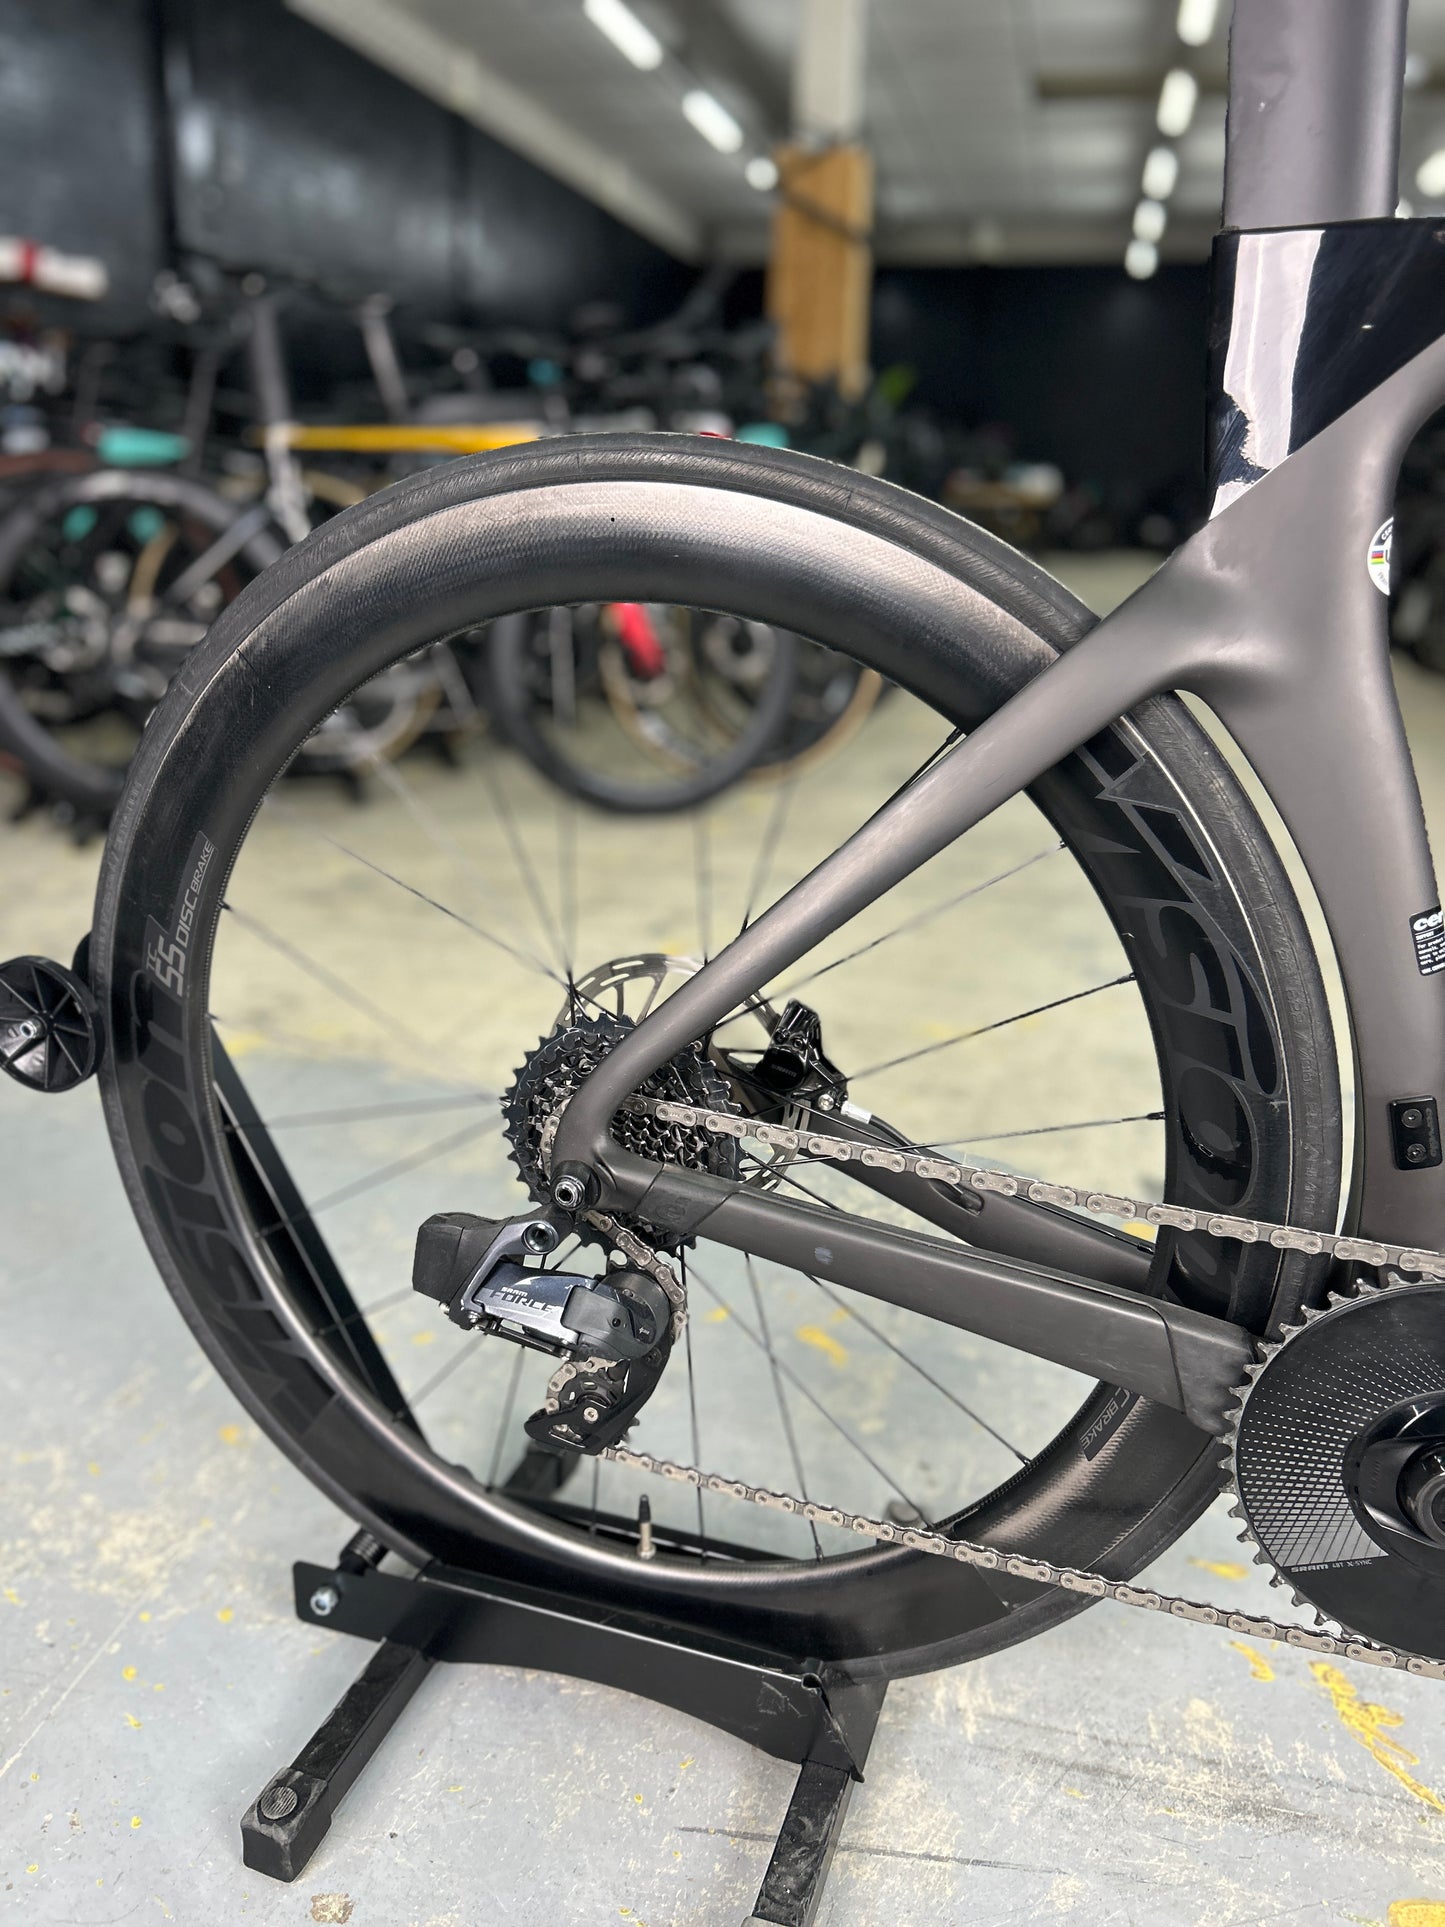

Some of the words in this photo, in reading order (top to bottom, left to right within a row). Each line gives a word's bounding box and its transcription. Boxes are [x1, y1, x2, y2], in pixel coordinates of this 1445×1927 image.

[155, 935, 187, 998] 55
[175, 888, 198, 949] DISC
[190, 840, 215, 895] BRAKE
[146, 942, 158, 972] TC
[490, 1291, 555, 1313] FORCE
[501, 1286, 528, 1297] SRAM
[1079, 1398, 1118, 1450] BRAKE
[1291, 1564, 1329, 1573] SRAM
